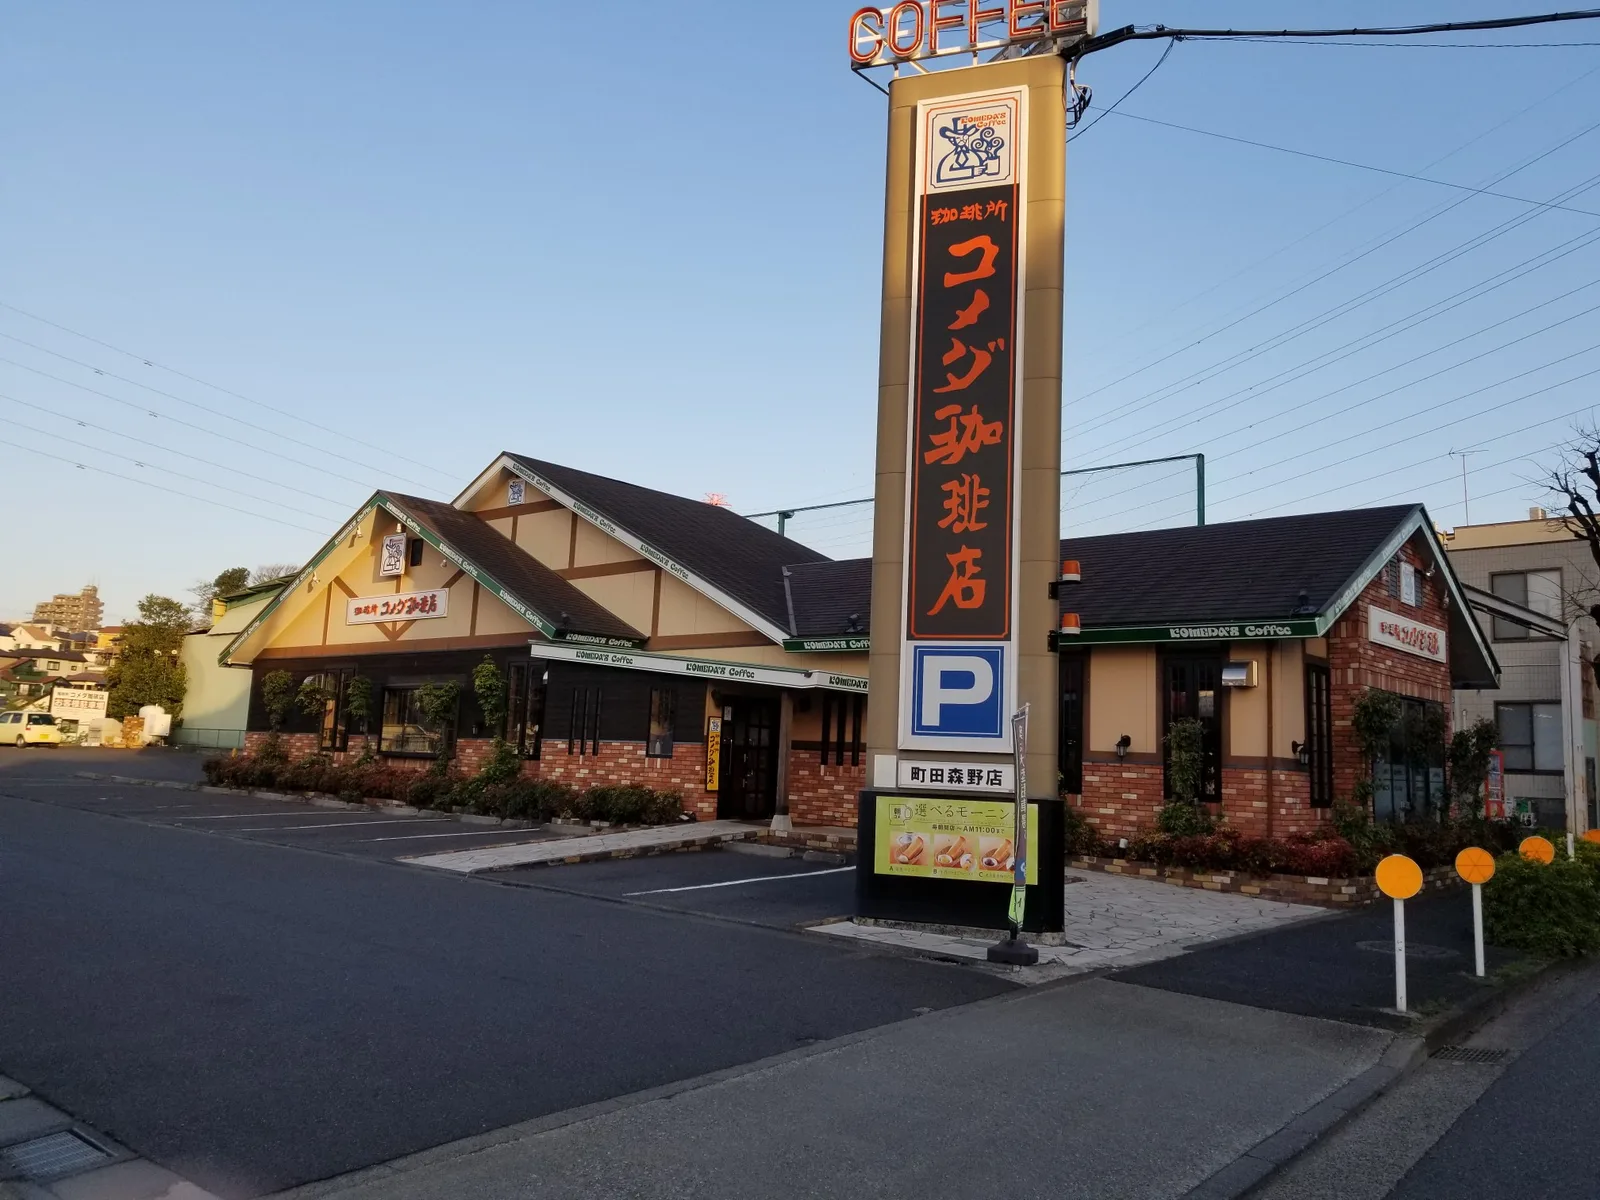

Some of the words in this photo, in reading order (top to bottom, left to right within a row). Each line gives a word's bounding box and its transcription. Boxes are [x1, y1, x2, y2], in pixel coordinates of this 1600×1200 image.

[976, 119, 1006, 128] Coffee
[930, 200, 1008, 226] 珈琲所
[923, 234, 1005, 615] コメダ珈琲店
[1169, 626, 1240, 638] KOMEDA'S
[1244, 625, 1292, 636] Coffee
[608, 638, 633, 648] Coffee
[803, 639, 847, 649] KOMEDA'S
[611, 654, 634, 665] Coffee
[685, 663, 726, 675] KOMEDA'S
[728, 667, 755, 679] Coffee
[829, 675, 868, 689] KOMEDA'S
[921, 655, 993, 726] P
[910, 766, 1003, 787] 町田森野店
[914, 803, 1014, 820] 選べるモーニン
